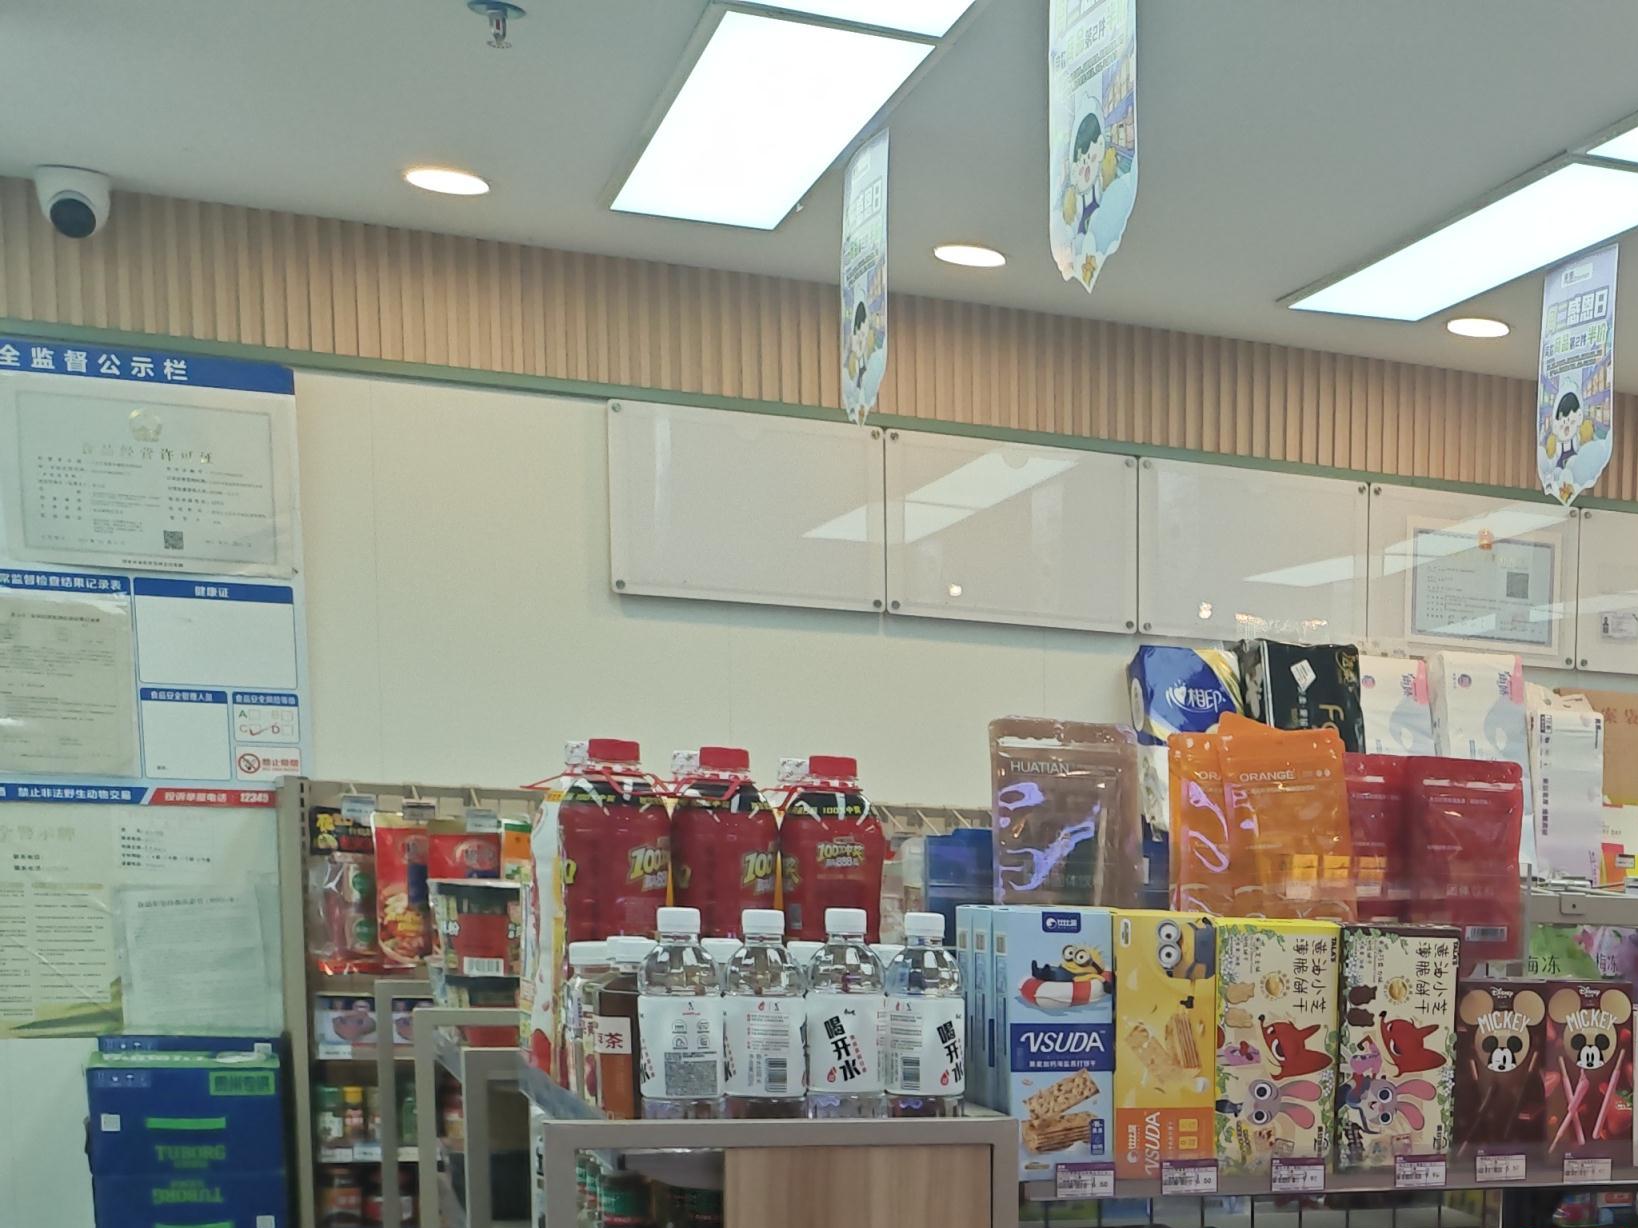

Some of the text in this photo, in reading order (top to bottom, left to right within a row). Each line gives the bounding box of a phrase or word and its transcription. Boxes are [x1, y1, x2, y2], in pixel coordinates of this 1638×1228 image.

[0, 343, 189, 381] 全监督公示栏
[195, 586, 229, 598] 健康证
[238, 710, 247, 719] A
[1011, 761, 1071, 774] HUATIAN
[1239, 770, 1296, 782] ORANGE
[18, 787, 132, 800] 禁止非法野生动物交易
[1292, 938, 1309, 1015] 薄脆饼干
[1311, 938, 1328, 1015] 黄油小芝
[1415, 942, 1431, 1015] 薄脆饼干
[1432, 943, 1450, 1015] 黄油小芝
[1490, 986, 1514, 997] Disney
[1579, 985, 1601, 996] Disney
[1477, 1010, 1531, 1033] MICKEY
[1566, 1008, 1618, 1032] MICKEY
[824, 1015, 861, 1082] 喝开水
[1020, 1031, 1105, 1053] VSUDA
[1144, 1111, 1161, 1175] VSUDA
